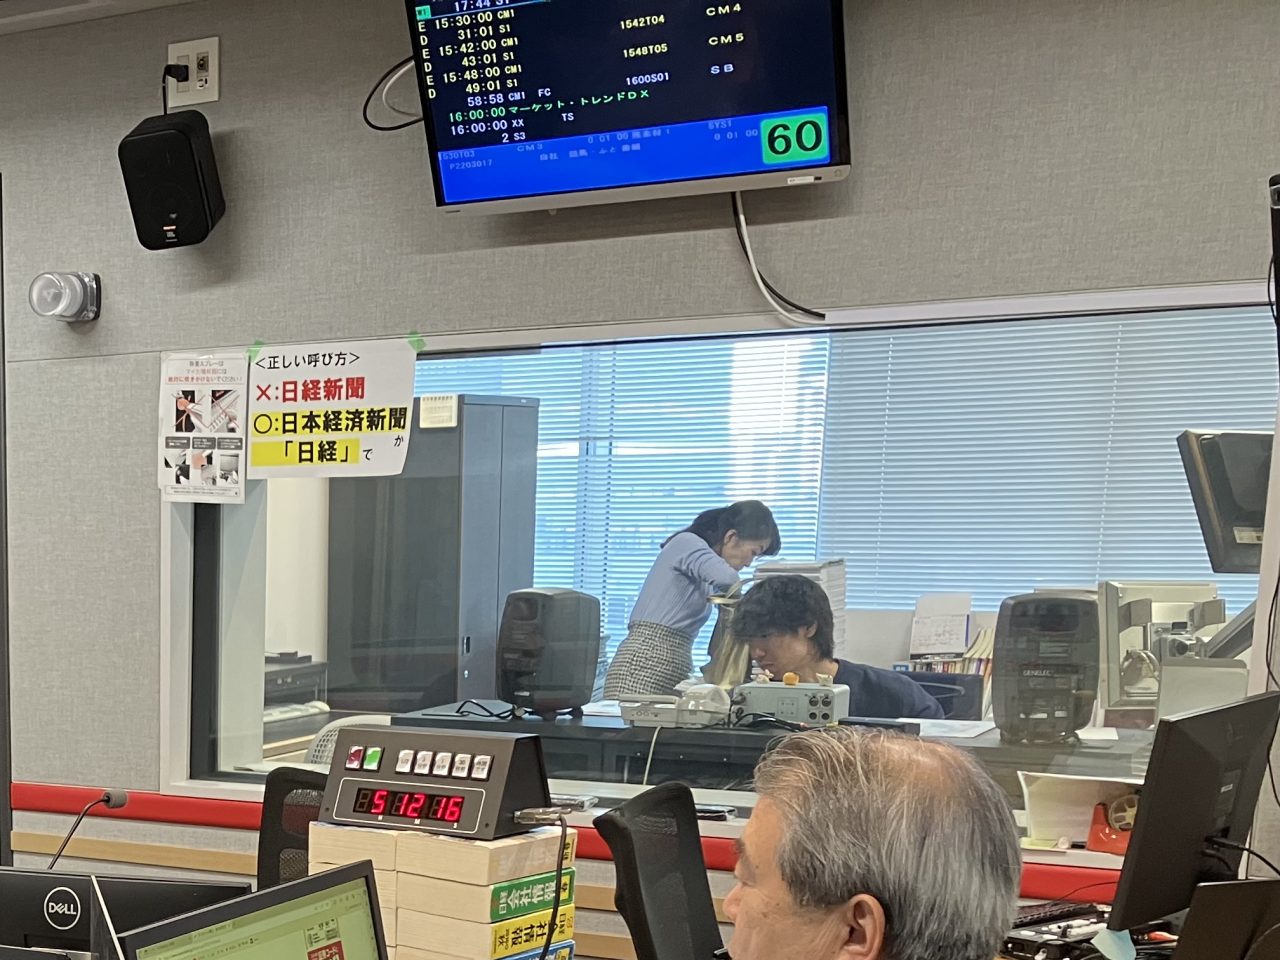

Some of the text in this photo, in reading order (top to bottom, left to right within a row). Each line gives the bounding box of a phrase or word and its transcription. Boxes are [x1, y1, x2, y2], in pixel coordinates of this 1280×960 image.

[418, 22, 426, 32] E
[434, 11, 493, 30] 15:30:00
[496, 9, 515, 20] CM1
[420, 24, 511, 46] D 31:01 S1
[422, 48, 430, 59] E
[438, 39, 497, 56] 15:42:00
[500, 37, 518, 47] CM1
[620, 14, 666, 30] 1542T04
[424, 52, 514, 72] D 43:01 S1
[426, 75, 434, 86] E
[442, 66, 500, 84] 15:48:00
[504, 64, 522, 74] CM1
[623, 43, 668, 58] 1548T05
[428, 78, 518, 99] D 49:01 S1
[467, 93, 504, 107] 58:58
[508, 91, 526, 101] CM1
[538, 88, 552, 98] FC
[626, 72, 670, 86] 1600S01
[448, 106, 506, 123] 16:00:00
[450, 112, 575, 136] 16:00:00 XX TS
[502, 132, 526, 143] 2 S3
[767, 119, 823, 156] 60
[371, 790, 463, 821] 5 12 16
[48, 902, 77, 915] DELL
